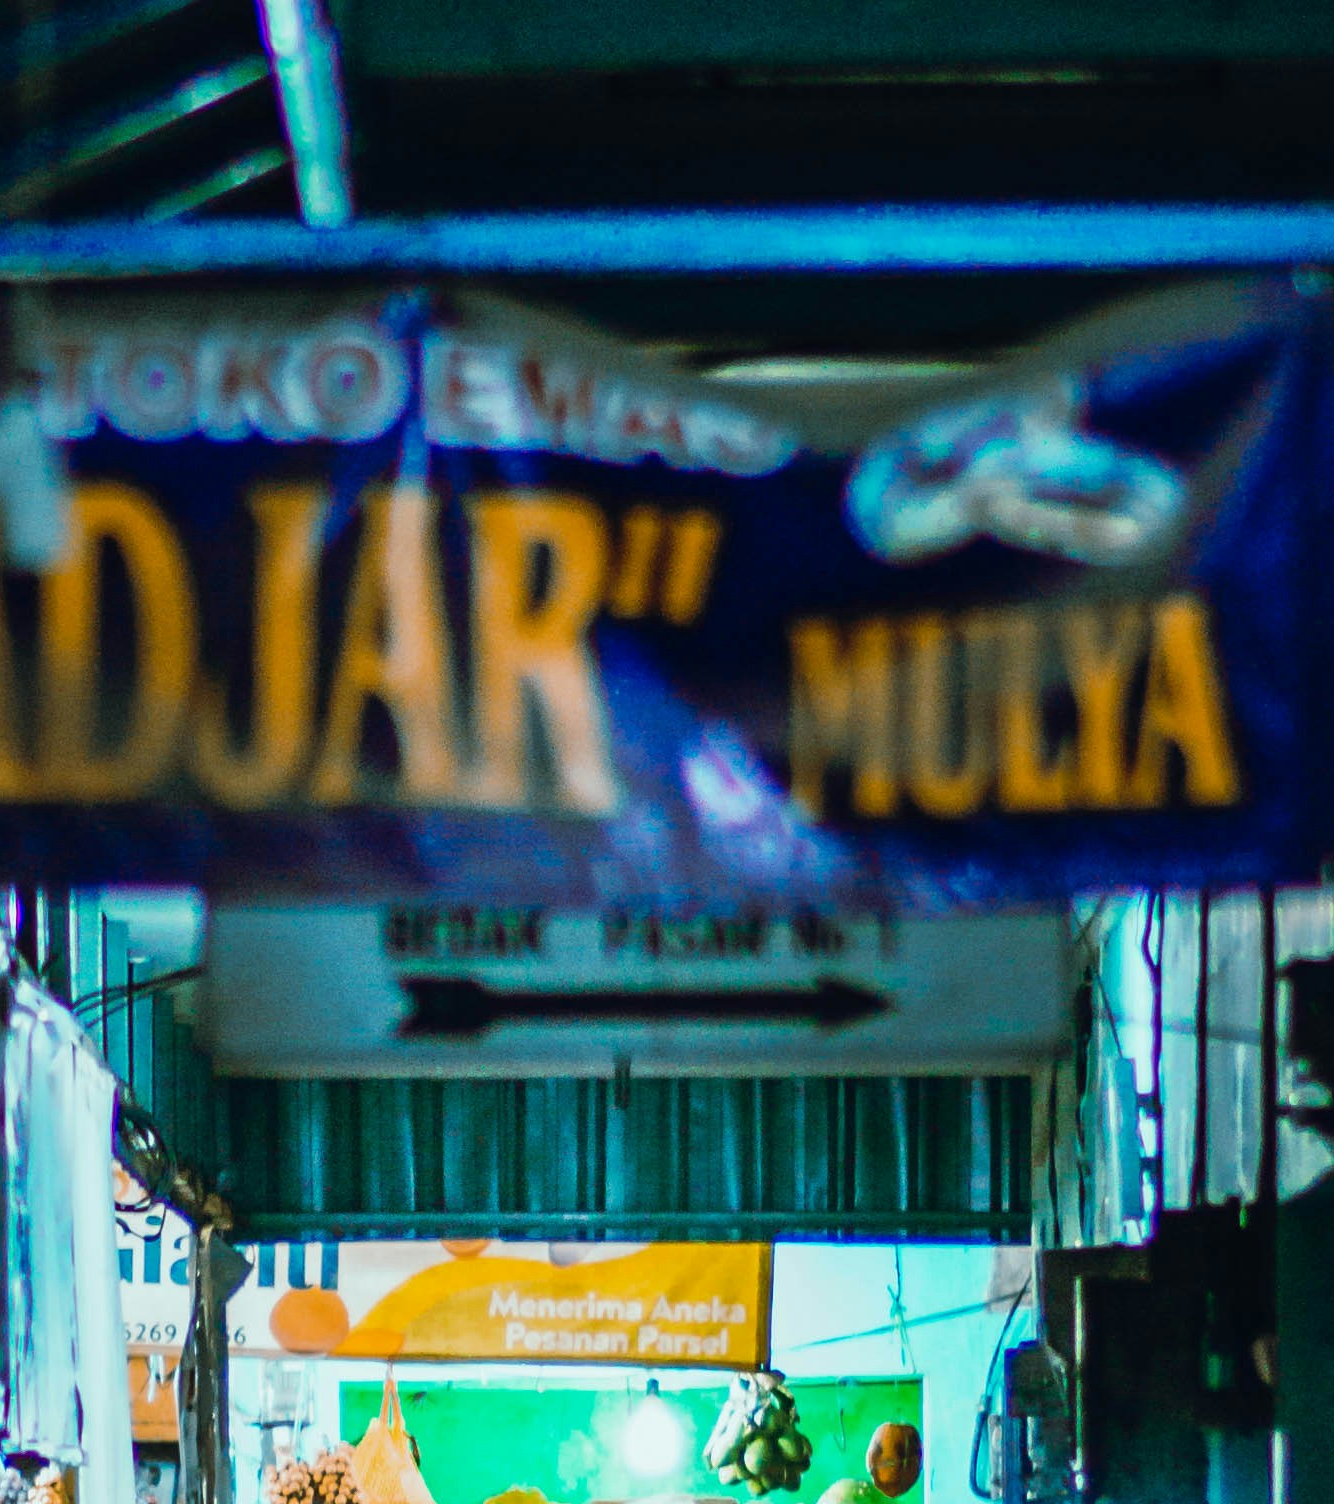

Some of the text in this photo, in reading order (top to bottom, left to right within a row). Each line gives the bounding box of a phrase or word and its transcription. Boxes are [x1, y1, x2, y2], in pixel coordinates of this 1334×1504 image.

[39, 330, 405, 442] TOKO
[783, 594, 1246, 826] MULYA
[488, 1290, 747, 1324] Menerima Aneka
[505, 1322, 729, 1357] Pesanan Parsel
